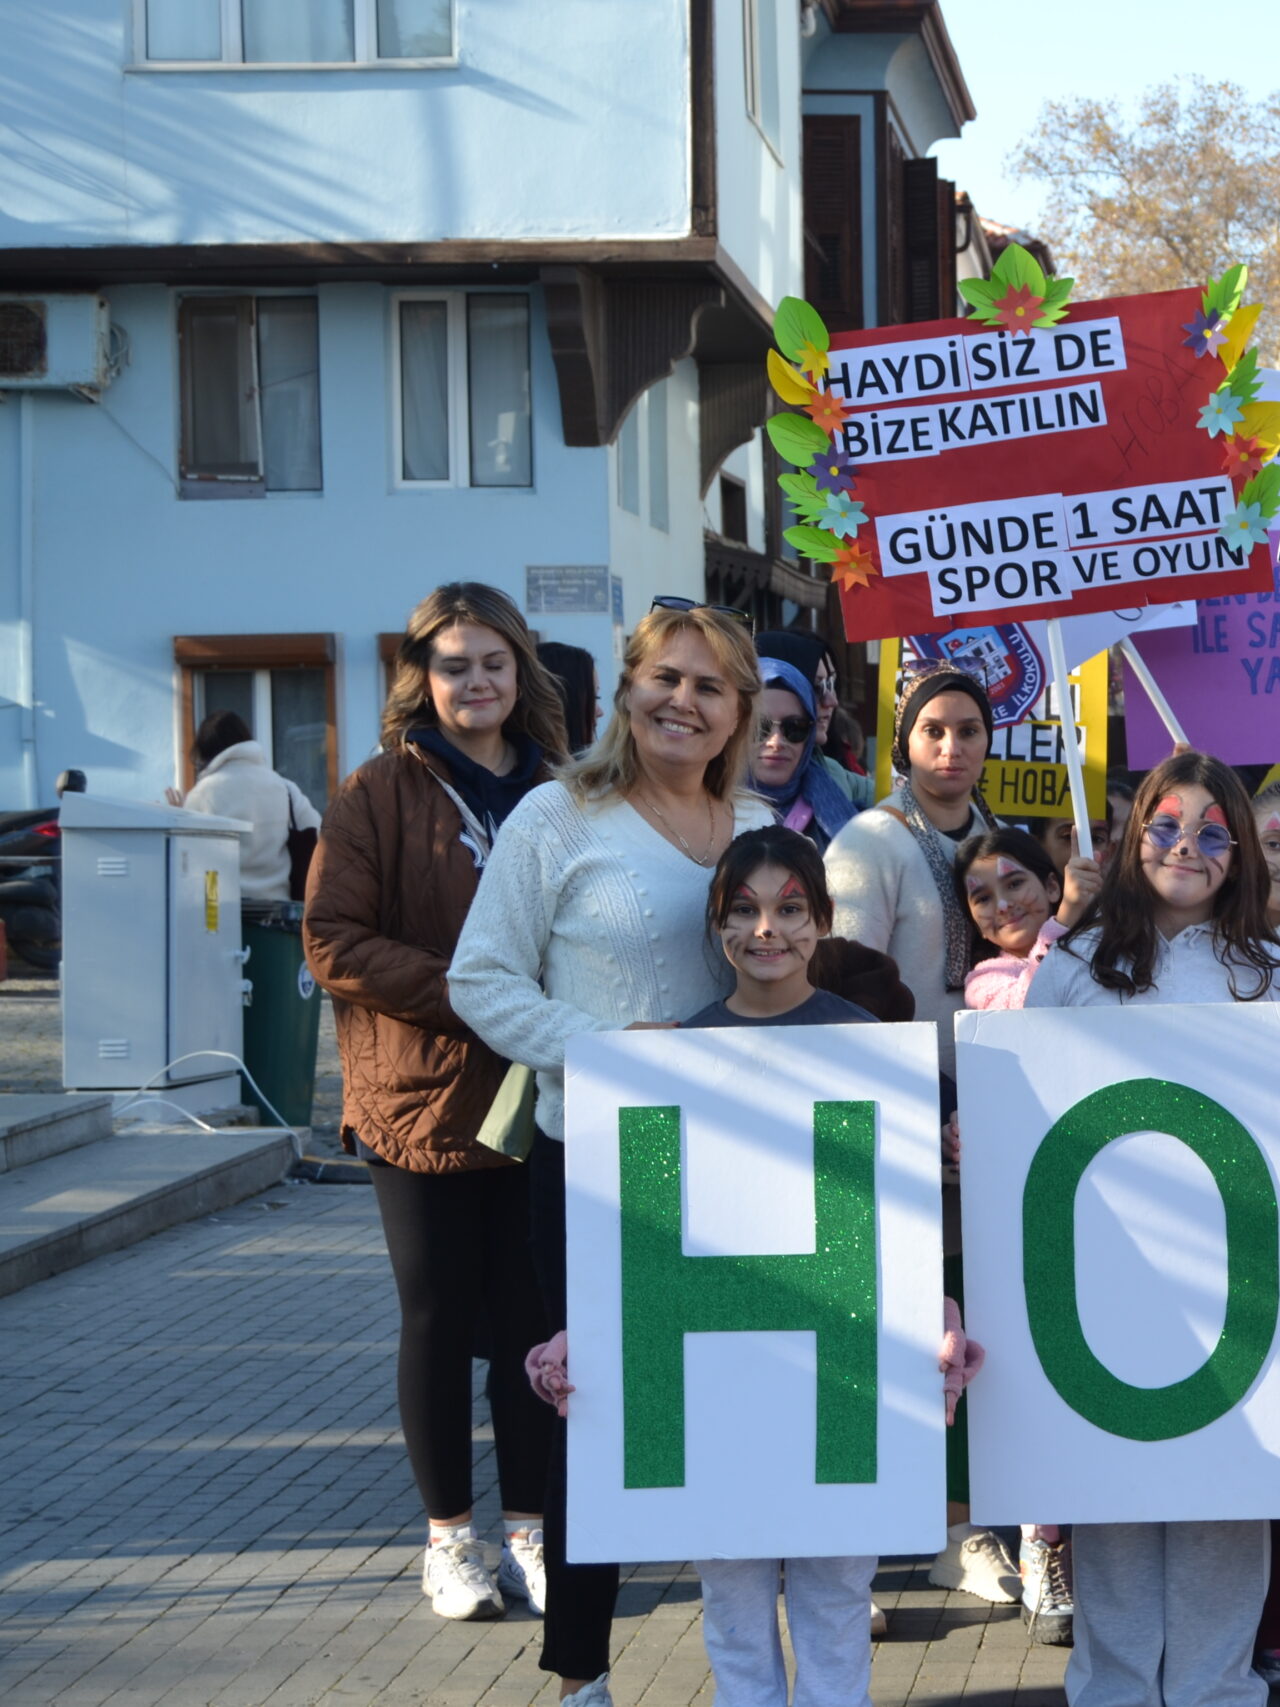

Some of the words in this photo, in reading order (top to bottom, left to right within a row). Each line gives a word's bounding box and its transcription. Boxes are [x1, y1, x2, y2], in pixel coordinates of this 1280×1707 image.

[823, 340, 961, 400] HAYDİ
[971, 331, 1040, 381] SİZ
[1054, 329, 1115, 371] DE
[842, 413, 933, 458] BİZE
[939, 389, 1100, 442] KATILIN
[889, 512, 1058, 565] GÜNDE
[1072, 502, 1098, 540] 1
[1113, 486, 1226, 535] SAAT
[937, 560, 1062, 605] SPOR
[1072, 551, 1121, 583] VE
[1133, 536, 1244, 577] OYUN
